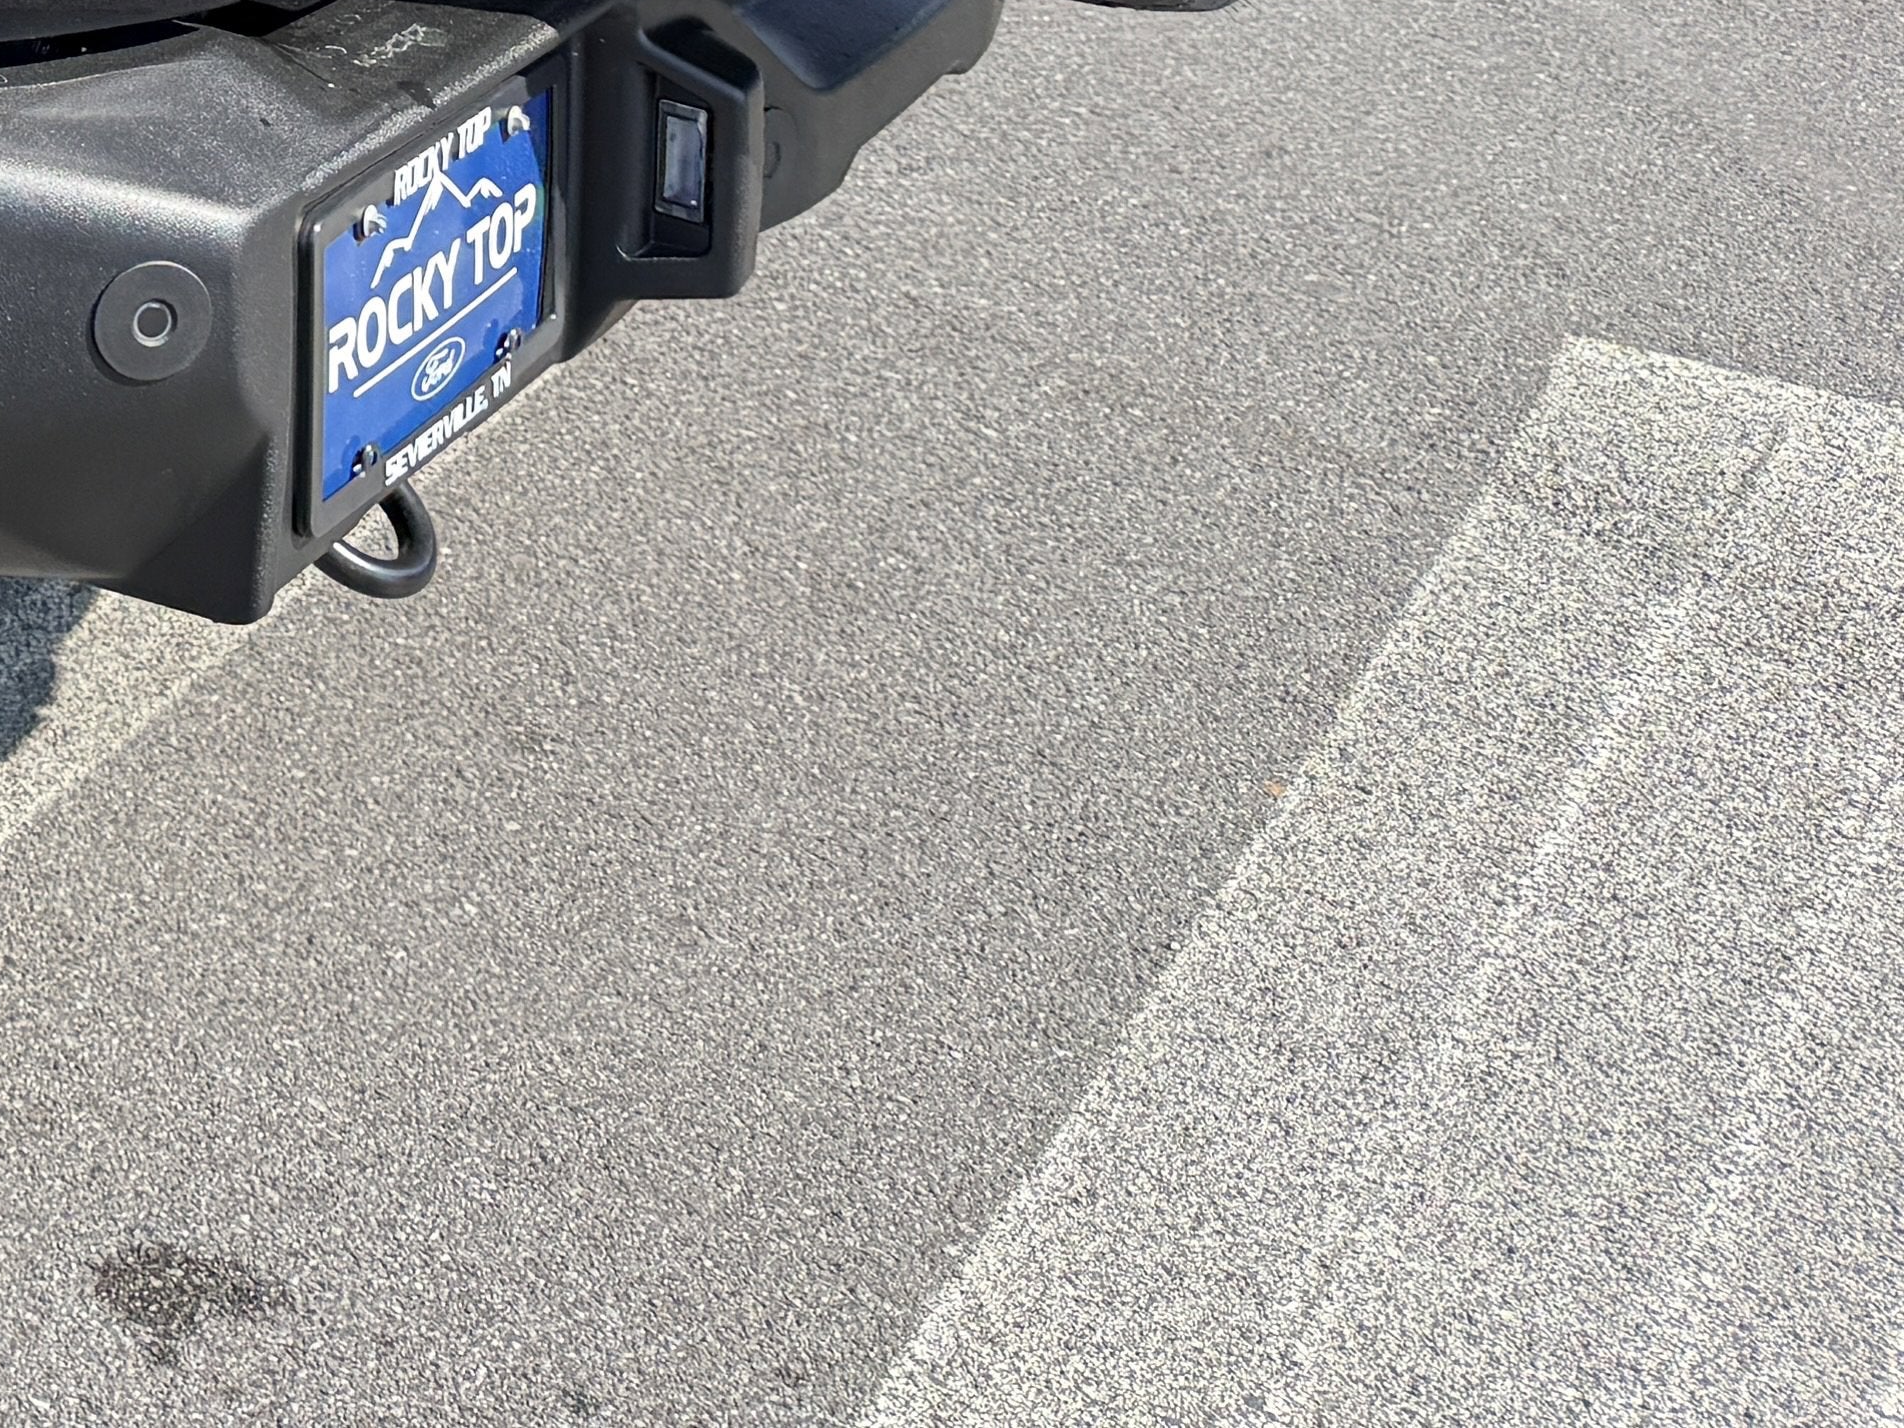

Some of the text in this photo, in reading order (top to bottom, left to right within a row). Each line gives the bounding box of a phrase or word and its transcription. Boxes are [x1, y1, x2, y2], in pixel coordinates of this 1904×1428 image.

[393, 106, 492, 207] ROCKY TOP
[327, 182, 537, 393] ROCKY TOP
[420, 346, 454, 394] Ford
[491, 360, 513, 400] TN
